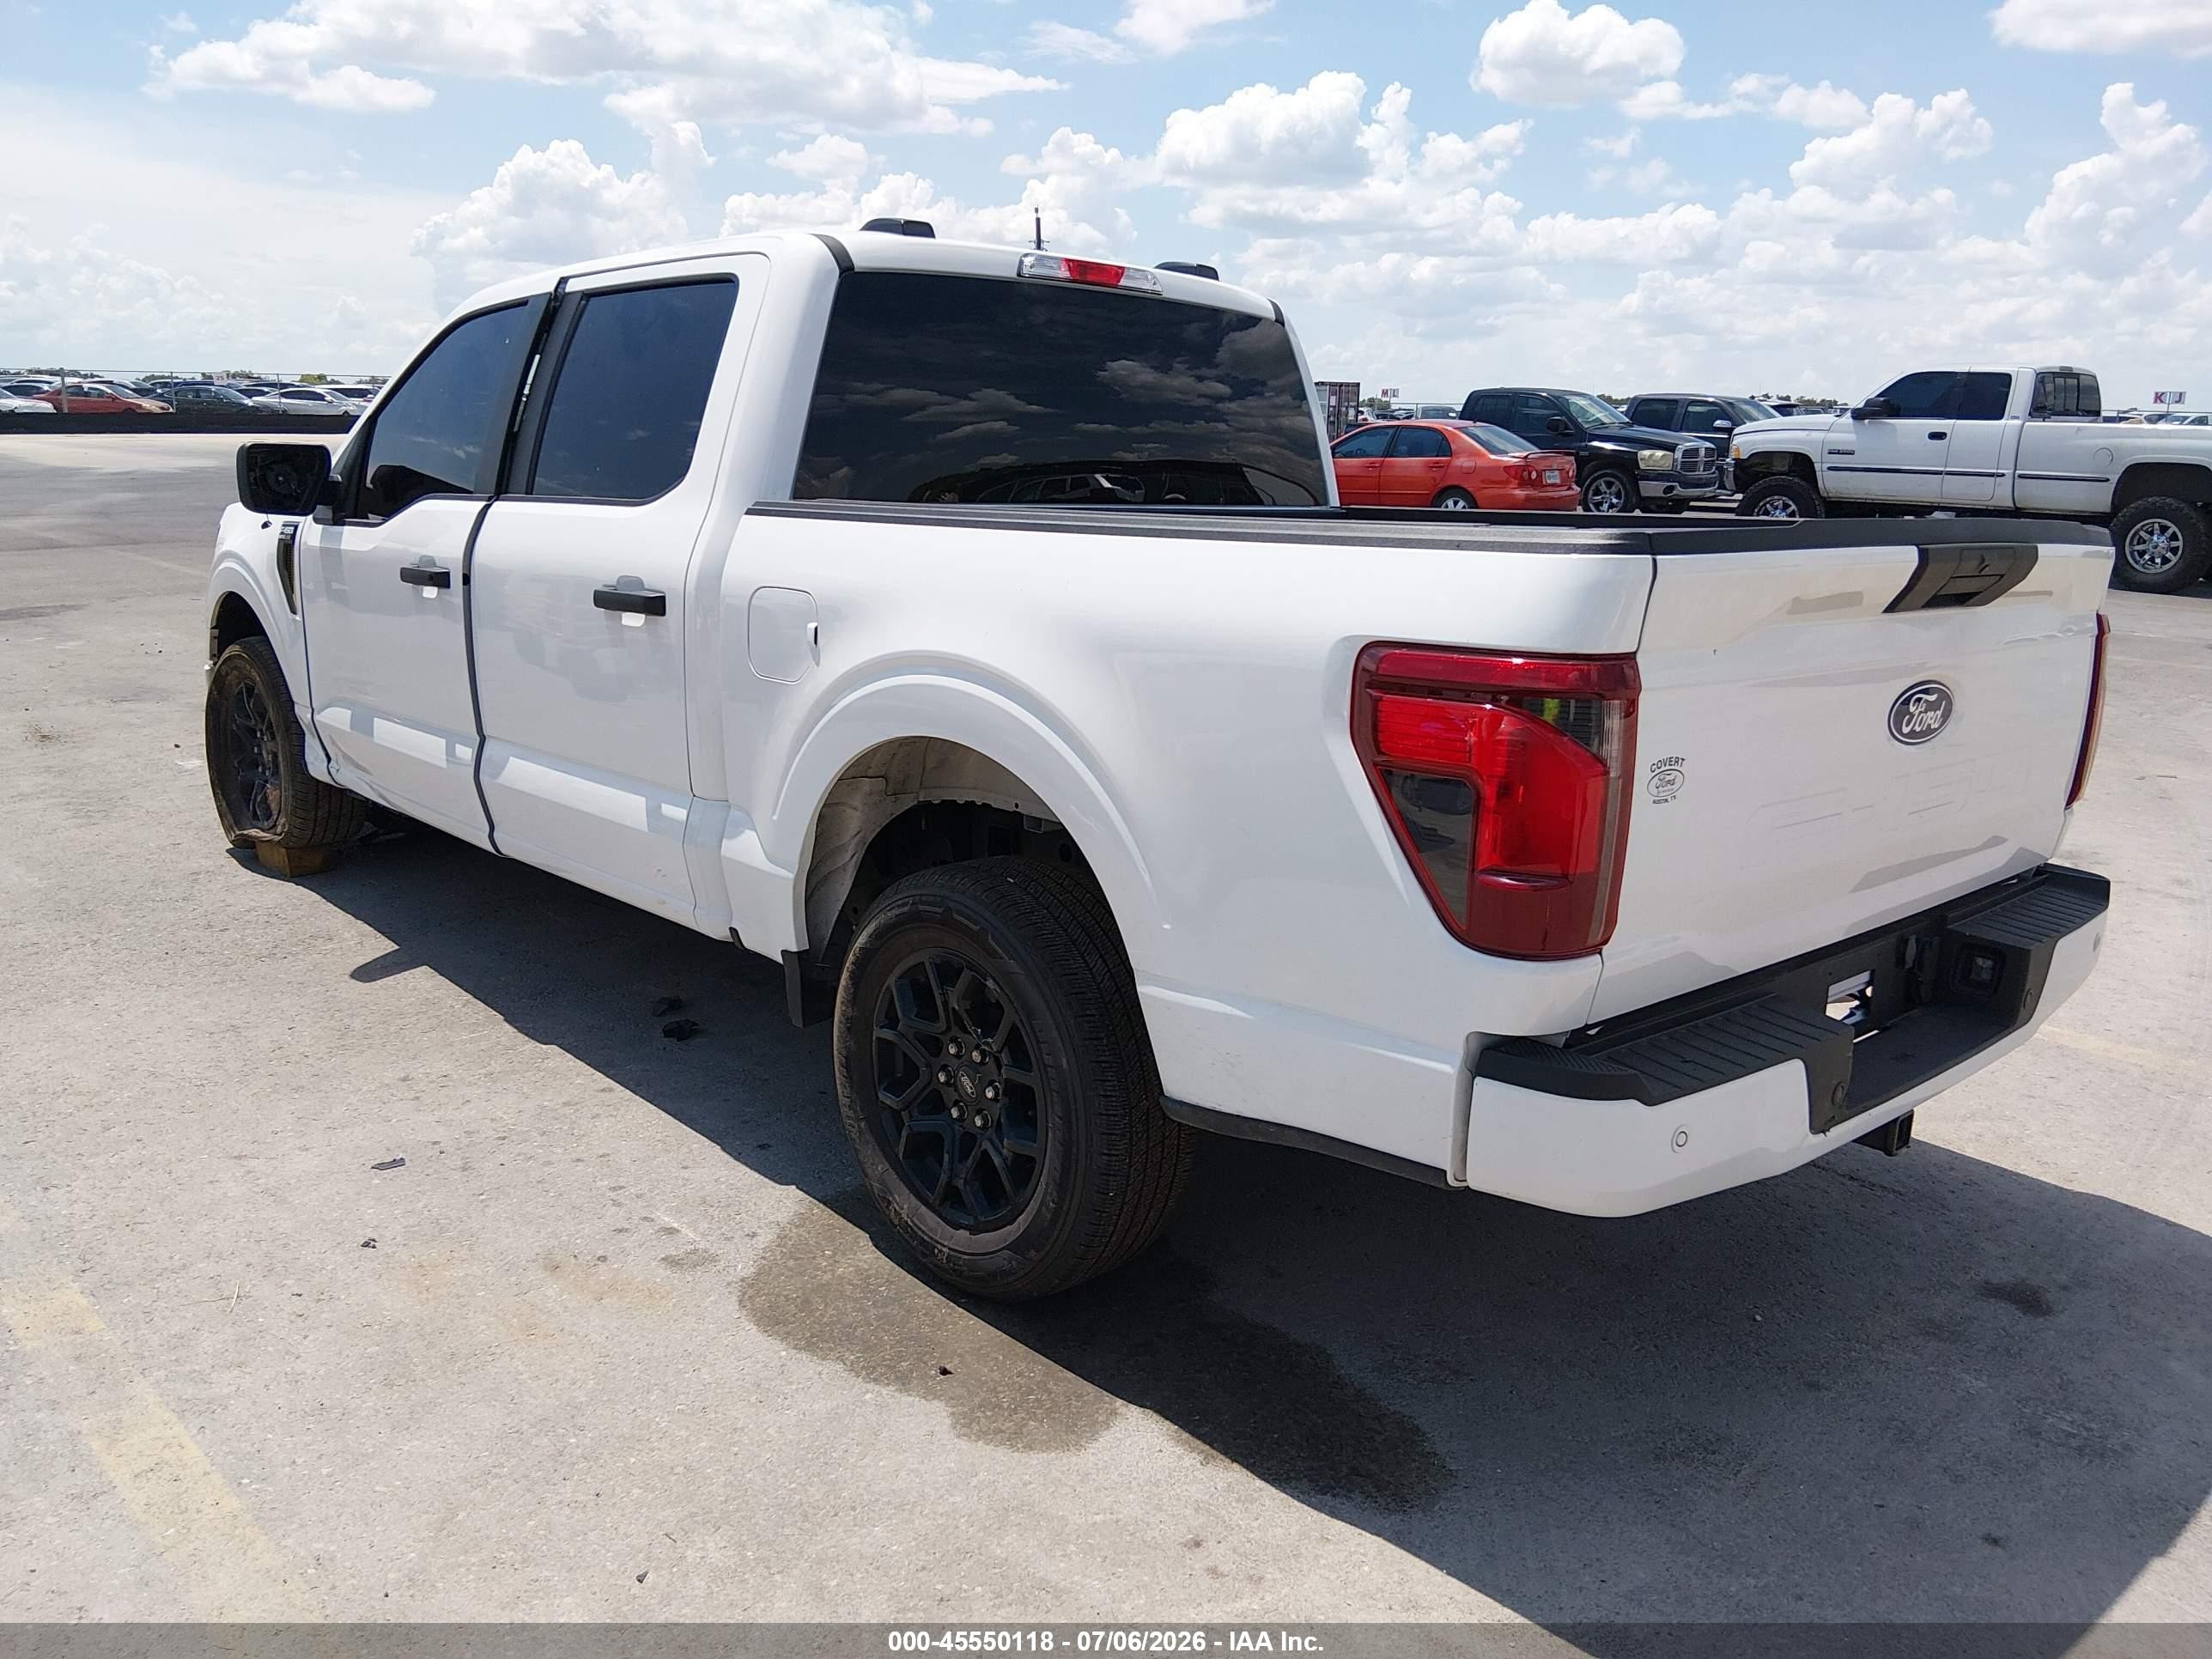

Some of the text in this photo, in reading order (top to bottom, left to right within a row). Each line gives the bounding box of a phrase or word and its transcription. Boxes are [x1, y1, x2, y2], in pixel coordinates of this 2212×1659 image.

[1381, 388, 1399, 398] M L
[2154, 392, 2183, 404] K J
[1902, 693, 1946, 734] Ford
[1650, 756, 1686, 773] COVERT
[1655, 773, 1678, 789] Ford
